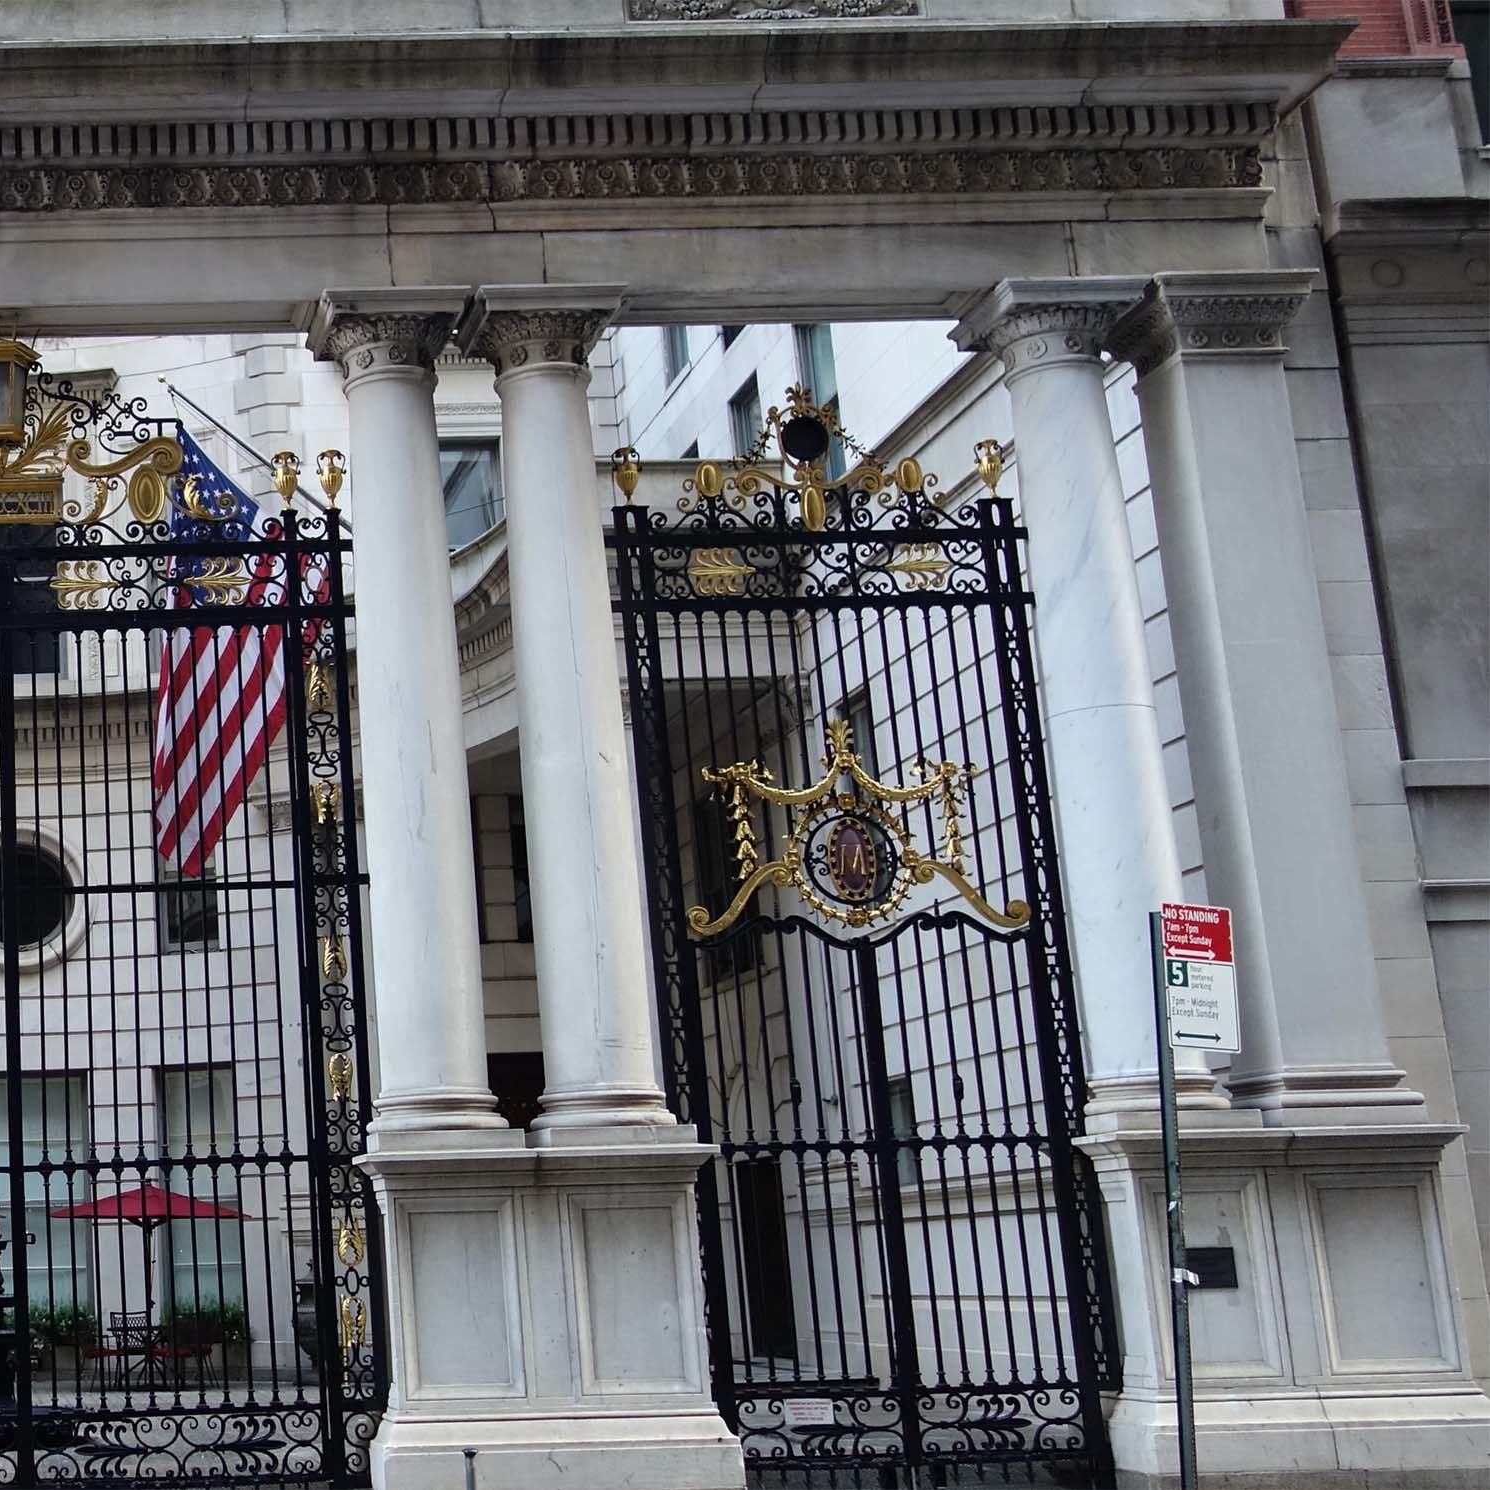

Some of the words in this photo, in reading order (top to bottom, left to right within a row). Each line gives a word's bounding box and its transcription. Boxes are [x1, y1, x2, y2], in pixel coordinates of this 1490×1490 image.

[840, 844, 868, 876] M
[1165, 907, 1178, 919] NO
[1179, 909, 1219, 924] STANDING
[1166, 921, 1180, 932] 7am
[1185, 923, 1199, 934] 7pm
[1166, 932, 1188, 944] Except
[1190, 934, 1212, 947] Sunday
[1172, 962, 1184, 985] 5
[1172, 996, 1186, 1007] 7pm
[1191, 998, 1219, 1009] Midnight
[1171, 1007, 1194, 1018] Except
[1195, 1009, 1219, 1021] Sunday
